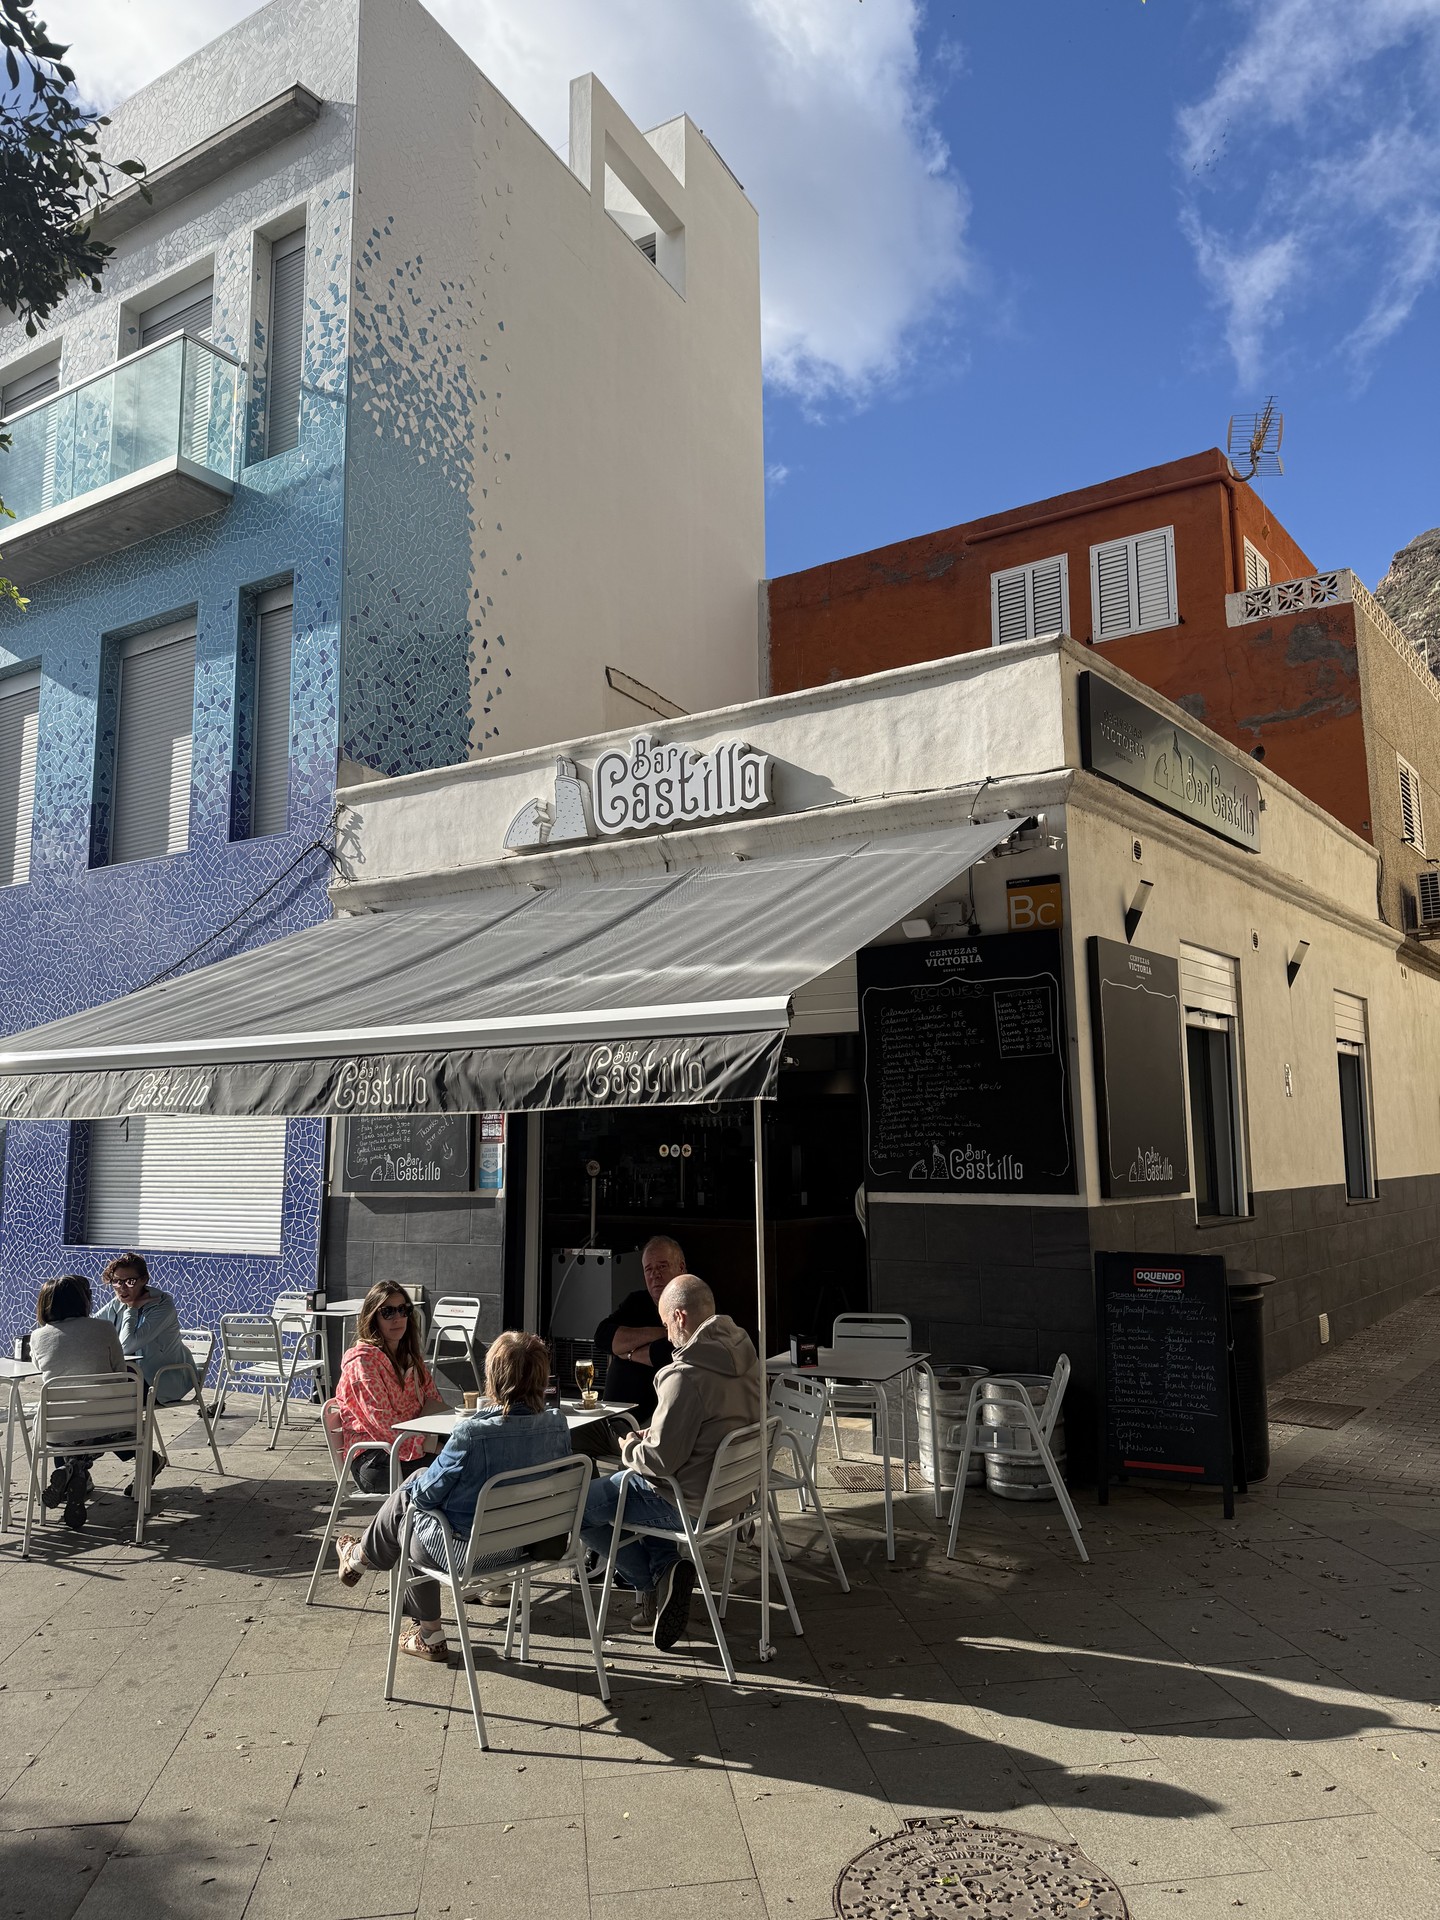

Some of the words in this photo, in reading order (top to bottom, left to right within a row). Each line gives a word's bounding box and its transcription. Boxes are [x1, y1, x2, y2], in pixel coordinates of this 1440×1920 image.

[1103, 710, 1143, 739] CERVEZAS
[1100, 722, 1146, 760] VICTORIA
[631, 738, 678, 781] Bar
[597, 743, 760, 828] Castillo
[1185, 755, 1209, 807] Bar
[1210, 764, 1255, 837] Castillo
[1009, 895, 1056, 929] Bc
[925, 954, 983, 967] VICTORIA
[929, 947, 978, 957] CERVEZAS
[1128, 961, 1152, 975] VICTORIA
[911, 984, 985, 1001] RACIONES
[613, 1041, 639, 1065] Bar
[153, 1070, 171, 1086] Bar
[358, 1060, 379, 1081] Bar
[585, 1045, 704, 1099] Castillo
[127, 1072, 210, 1111] Castillo
[335, 1062, 429, 1110] Castillo
[406, 1152, 420, 1167] Bar
[950, 1149, 1024, 1180] Castillo
[965, 1144, 986, 1161] Bar
[1150, 1146, 1159, 1163] Bar
[396, 1157, 441, 1181] Castillo
[1145, 1151, 1173, 1181] Castillo
[1136, 1271, 1182, 1282] OQUENDO
[1111, 1352, 1140, 1361] Bacon
[1165, 1352, 1195, 1361] Bacon
